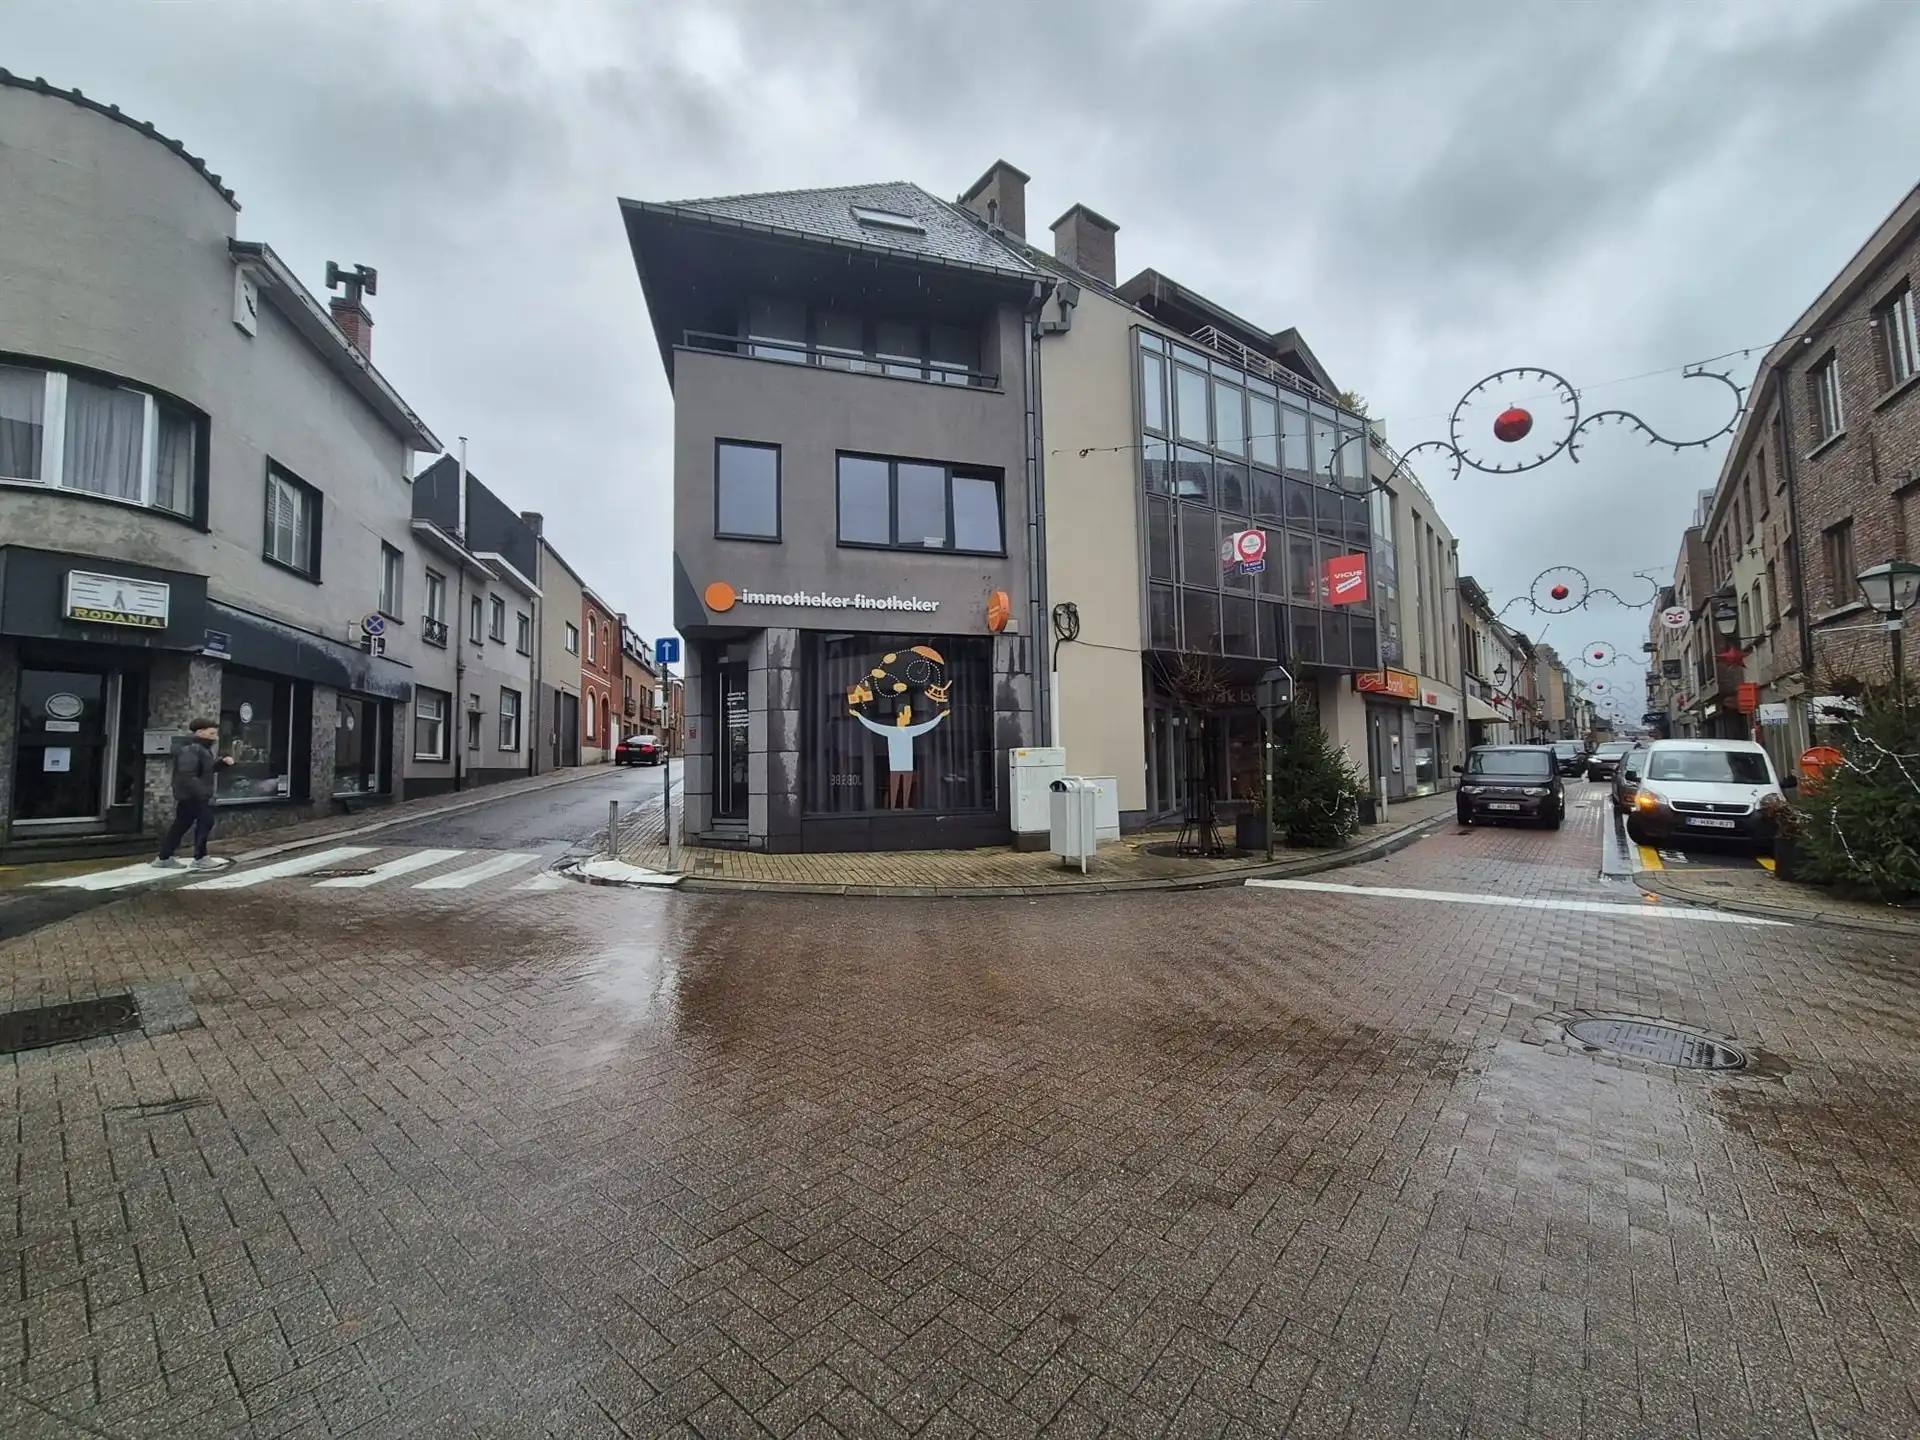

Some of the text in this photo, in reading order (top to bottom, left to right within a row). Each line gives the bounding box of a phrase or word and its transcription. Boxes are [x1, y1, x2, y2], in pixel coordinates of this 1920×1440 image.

[1333, 570, 1363, 579] VICUS
[74, 607, 161, 627] RODANIA
[1387, 675, 1404, 693] bank
